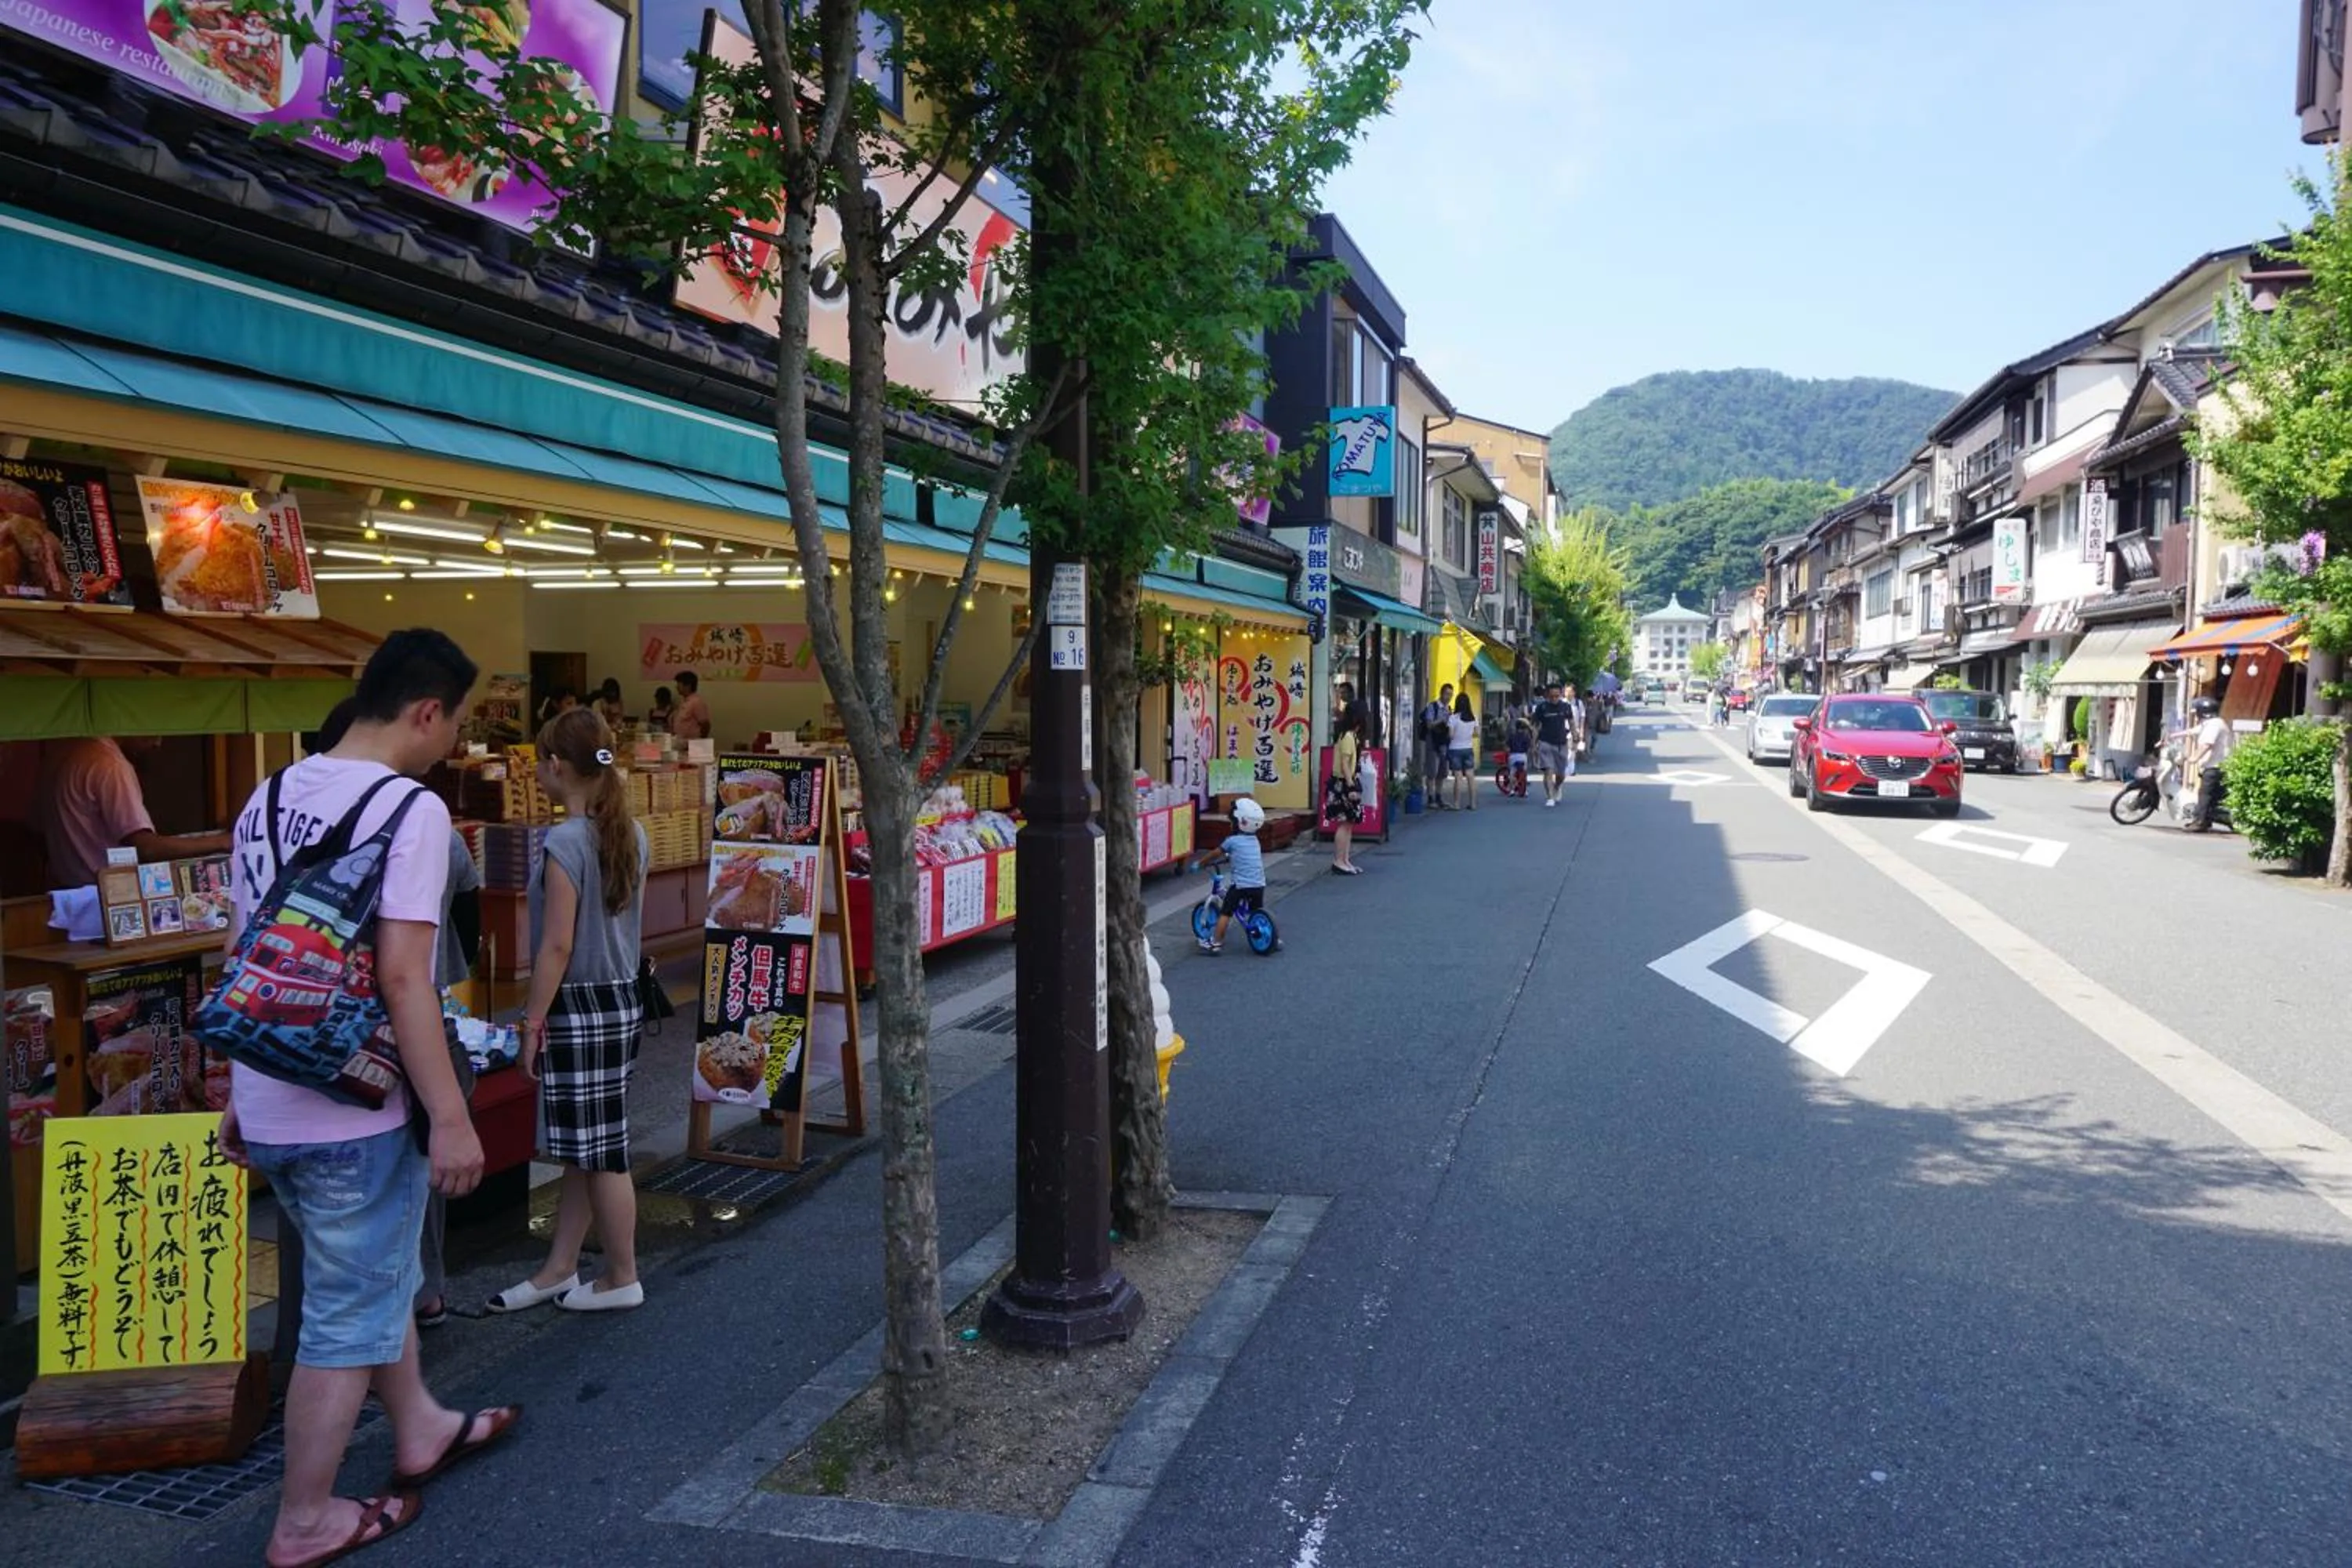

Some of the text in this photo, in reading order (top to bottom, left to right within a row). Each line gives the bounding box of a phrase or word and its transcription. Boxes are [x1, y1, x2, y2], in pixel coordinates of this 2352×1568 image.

[1068, 630, 1076, 644] 9
[1072, 648, 1084, 666] 16
[1253, 652, 1279, 784] おみやげ百選
[727, 936, 748, 1022] メンチカツ
[749, 945, 773, 1011] 但馬牛
[103, 1147, 145, 1360] お茶でもどうぞ
[148, 1142, 187, 1363] 店内で休憩して
